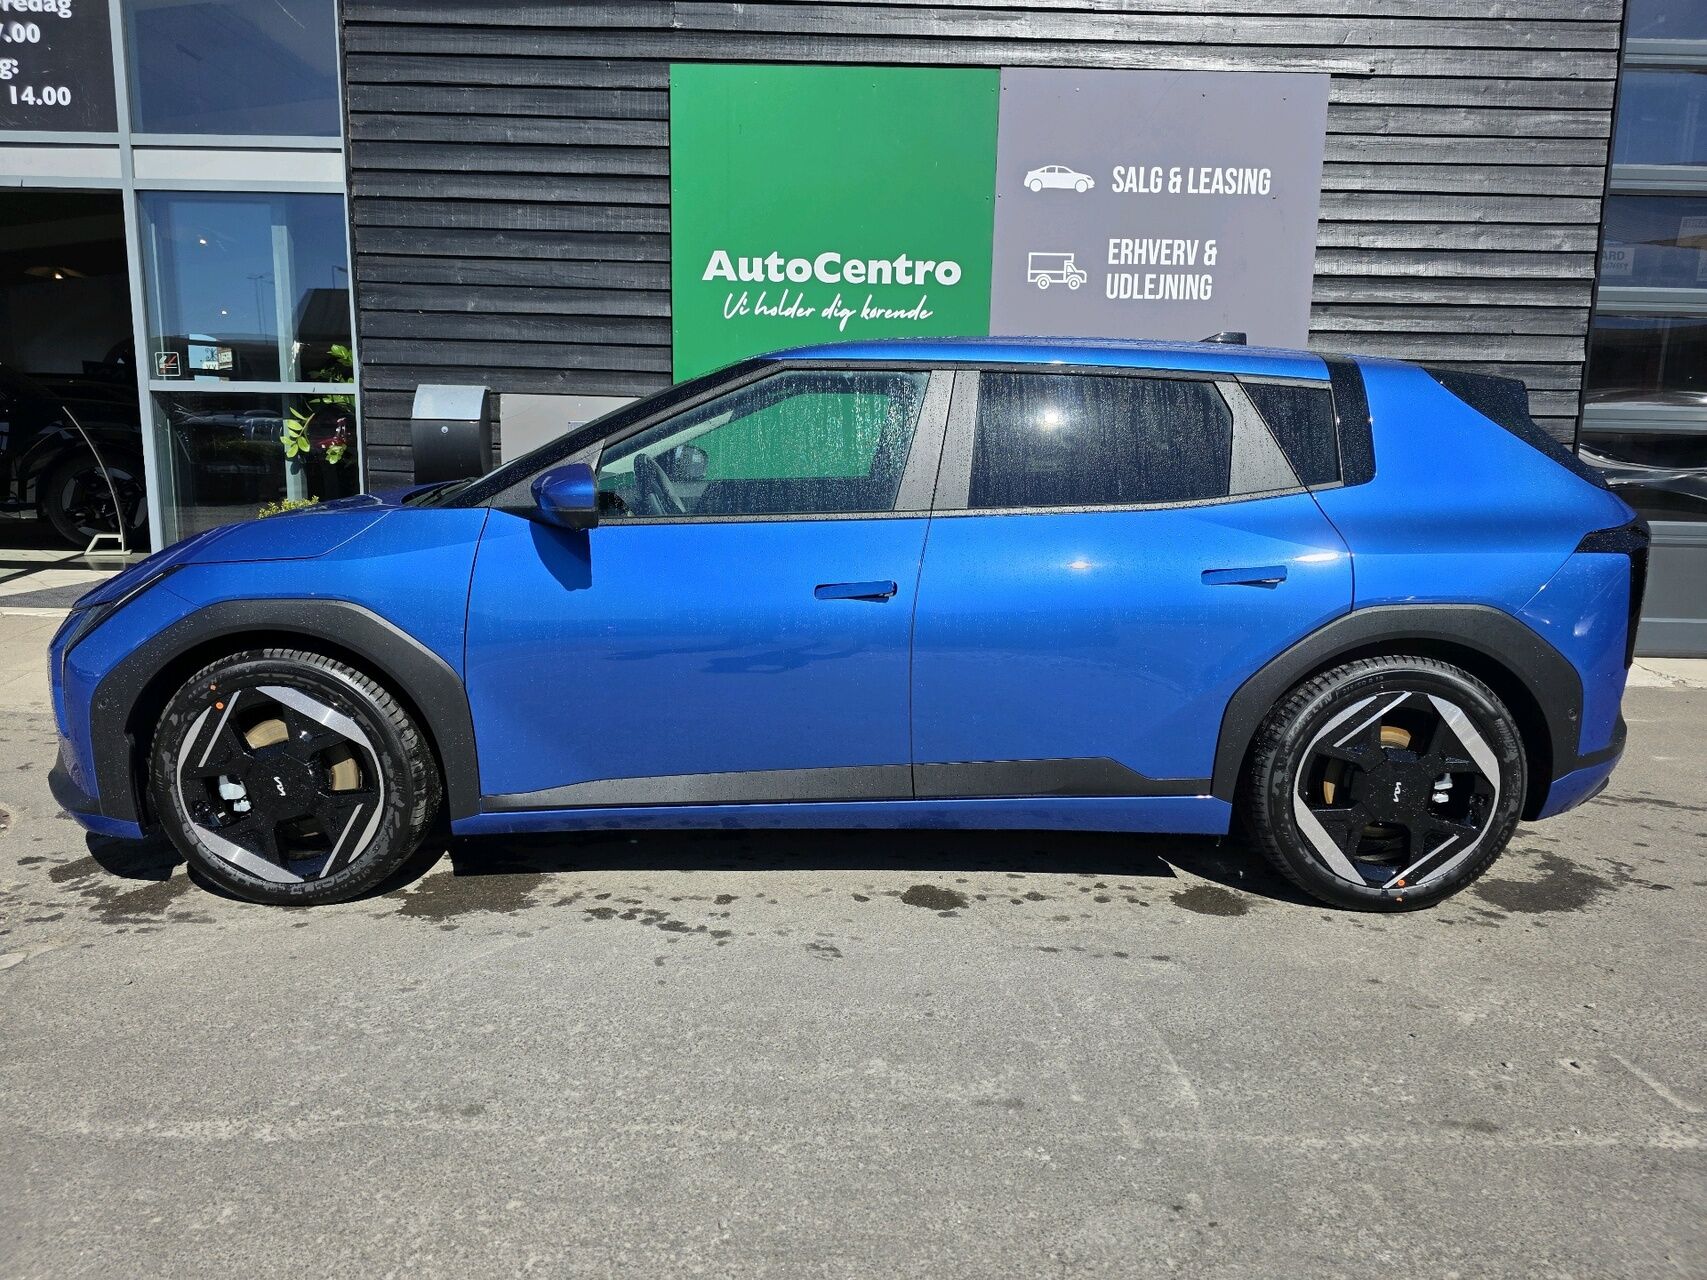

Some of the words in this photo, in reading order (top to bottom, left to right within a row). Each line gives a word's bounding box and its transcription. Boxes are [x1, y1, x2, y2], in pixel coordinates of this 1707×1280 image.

[0, 0, 72, 19] redag
[9, 85, 72, 106] 14.00
[1111, 165, 1163, 194] SALG
[1167, 166, 1182, 194] &
[1187, 167, 1272, 195] LEASING
[1107, 238, 1199, 266] ERHVERV
[1203, 239, 1218, 266] &
[701, 250, 962, 286] AutoCentro
[1105, 273, 1213, 301] UDLEJNING
[723, 290, 750, 320] Vi
[754, 288, 816, 319] holder
[821, 292, 857, 332] dig
